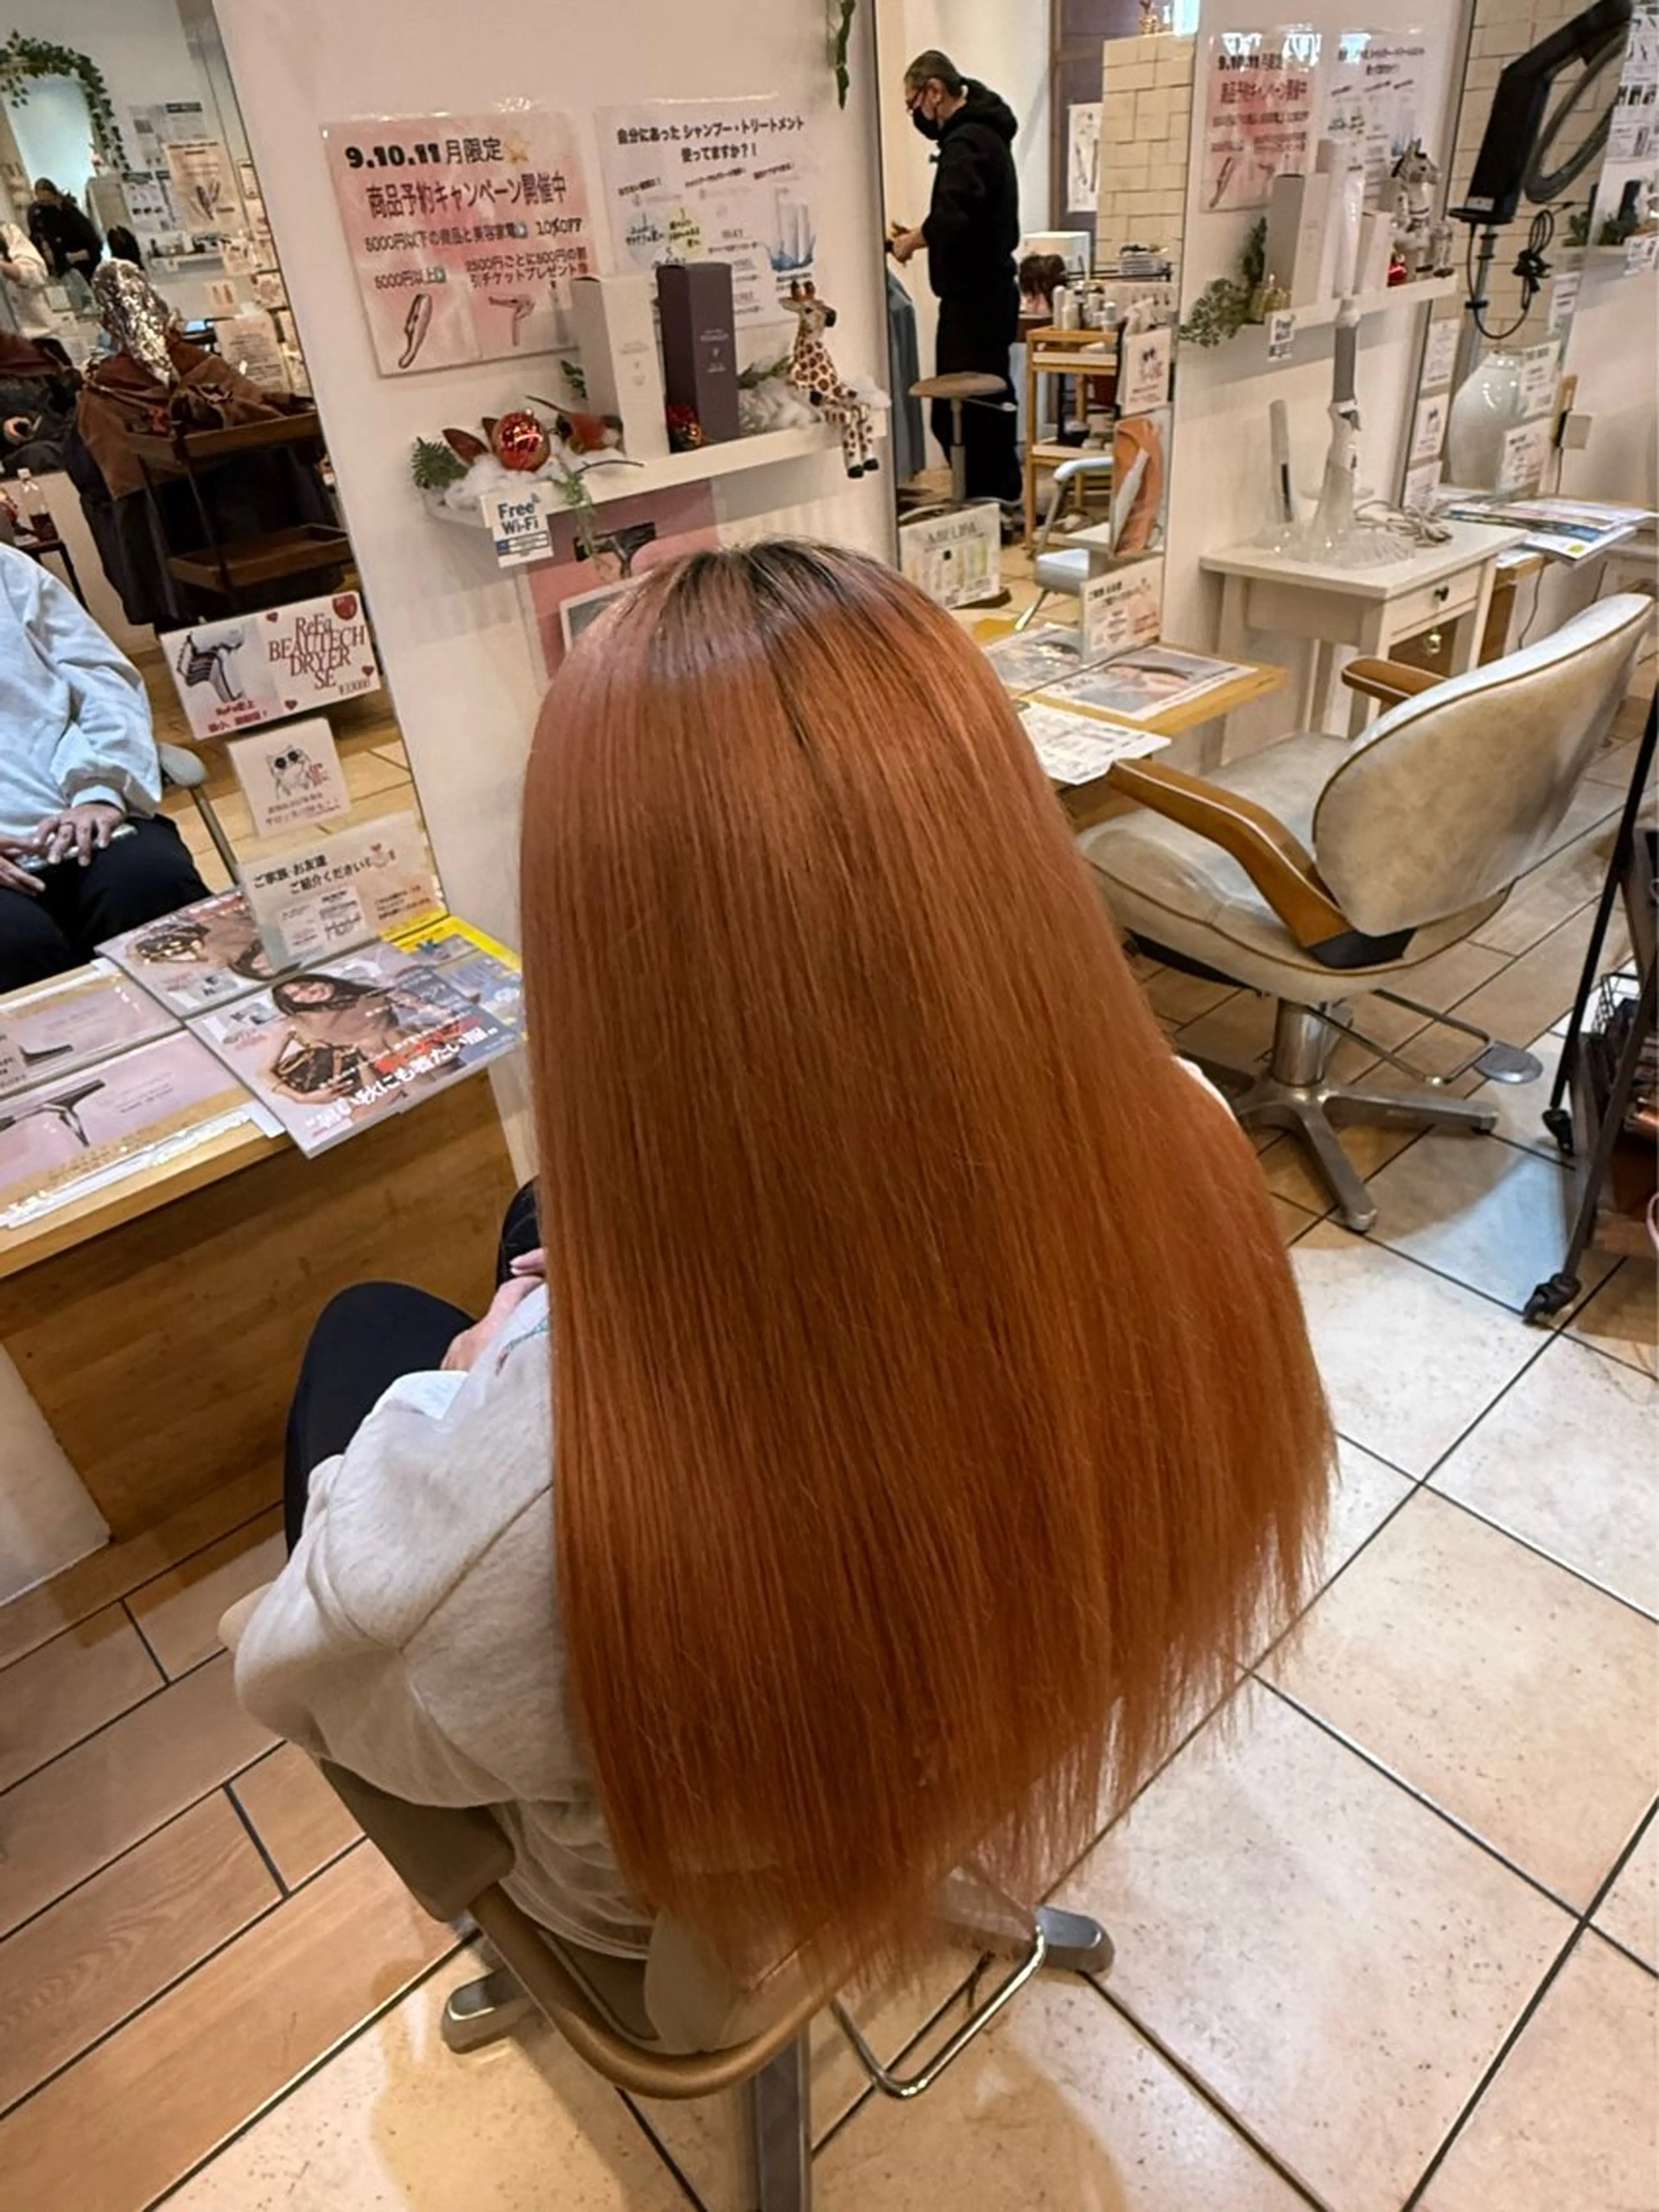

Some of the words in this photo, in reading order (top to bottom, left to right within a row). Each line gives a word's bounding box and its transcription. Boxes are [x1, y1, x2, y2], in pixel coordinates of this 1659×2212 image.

[366, 171, 566, 219] 商品予約キャンペーン開催中
[498, 501, 534, 519] Free
[501, 515, 539, 534] Wi-Fi
[296, 613, 332, 637] ReFa
[269, 625, 365, 661] BEAUTECH
[290, 647, 351, 677] DRYER
[315, 668, 337, 690] SE
